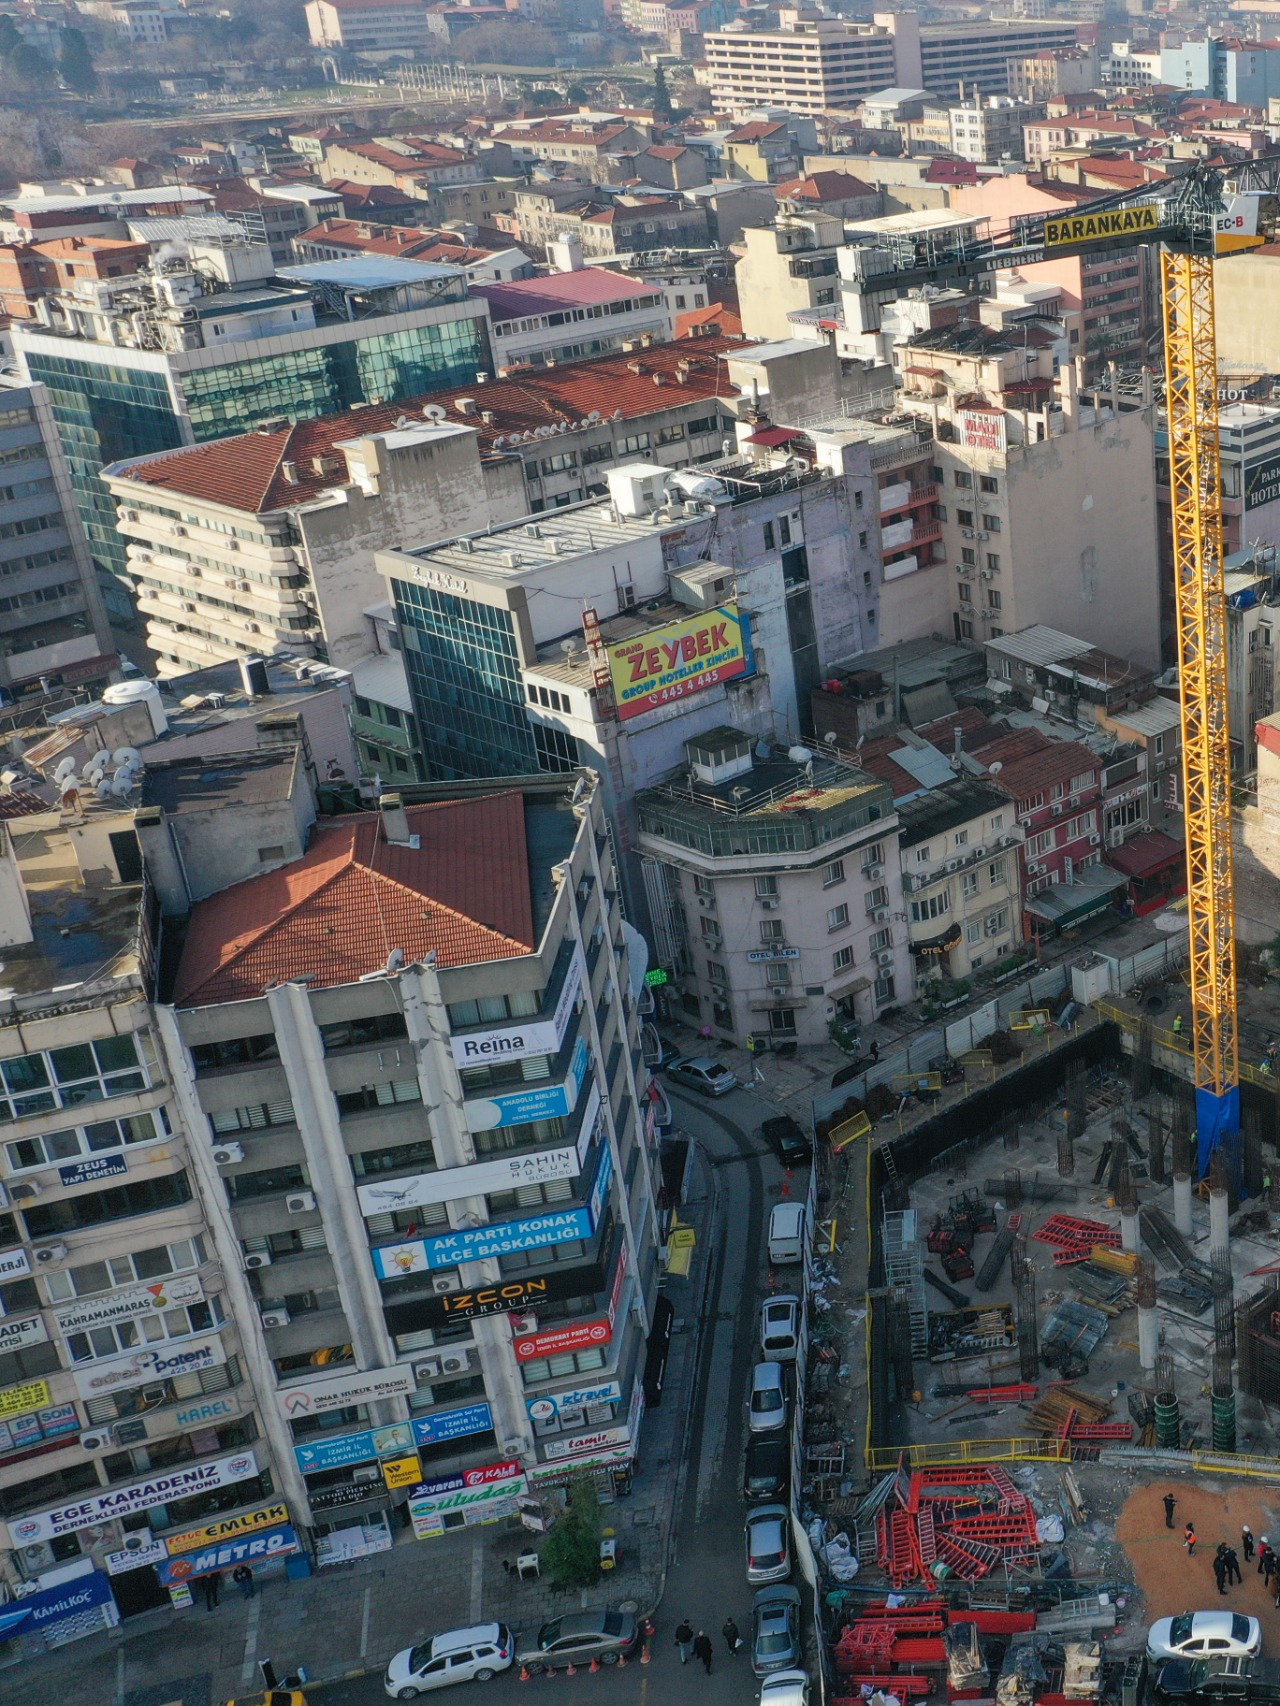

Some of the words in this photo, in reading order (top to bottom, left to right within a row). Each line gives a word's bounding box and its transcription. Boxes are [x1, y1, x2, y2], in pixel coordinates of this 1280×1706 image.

[1047, 208, 1155, 242] BARANKAYA
[1216, 216, 1244, 231] EC-B
[985, 252, 1044, 272] LIEBHERR
[614, 642, 644, 659] GRAND
[627, 622, 729, 682] ZEYBEK
[621, 679, 657, 700] GROUP
[658, 661, 705, 687] HOTELLER
[706, 644, 740, 668] ZİNCİRİ
[661, 683, 684, 700] 445
[687, 679, 694, 690] 4
[697, 669, 719, 686] 445
[921, 947, 943, 955] OTEL
[463, 1034, 525, 1057] Reina
[502, 1095, 534, 1107] ANADOLU
[63, 1174, 84, 1185] YAPI
[86, 1165, 126, 1179] DENETİM
[76, 1158, 108, 1173] ZEUS
[511, 1162, 571, 1179] HUKUK
[528, 1169, 573, 1182] BÜROSU
[433, 1236, 459, 1251] AK
[518, 1213, 577, 1234] KONAK
[478, 1226, 580, 1255] BAŞKANLIĞI
[465, 1294, 530, 1317] GROUP
[155, 1345, 213, 1373] patent
[170, 1365, 187, 1376] 425
[189, 1362, 200, 1371] 20
[203, 1358, 214, 1367] 40
[314, 1393, 338, 1404] ONAR
[341, 1386, 371, 1397] HUKUK
[374, 1379, 407, 1390] BÜROSU
[438, 1421, 489, 1437] BAŞKANLIĞI
[445, 1418, 469, 1428] İZMİR
[328, 1445, 352, 1456] İZMİR
[568, 1433, 608, 1449] tamir
[321, 1448, 371, 1465] BAŞKANLIĞI
[389, 1468, 420, 1479] Western
[390, 1474, 413, 1485] Union
[485, 1464, 516, 1479] KALE
[50, 1502, 93, 1525] EGE
[99, 1464, 219, 1510] KARADENİZ
[310, 1491, 345, 1503] TATTOO
[346, 1481, 384, 1495] PIERCING
[428, 1478, 463, 1494] varan
[436, 1480, 526, 1510] uludağ
[53, 1504, 131, 1534] DERNEKLERİ
[134, 1477, 222, 1509] FEDERASYONU
[333, 1492, 363, 1503] STUDIO
[110, 1541, 160, 1564] EPSON
[194, 1533, 285, 1572] METRO
